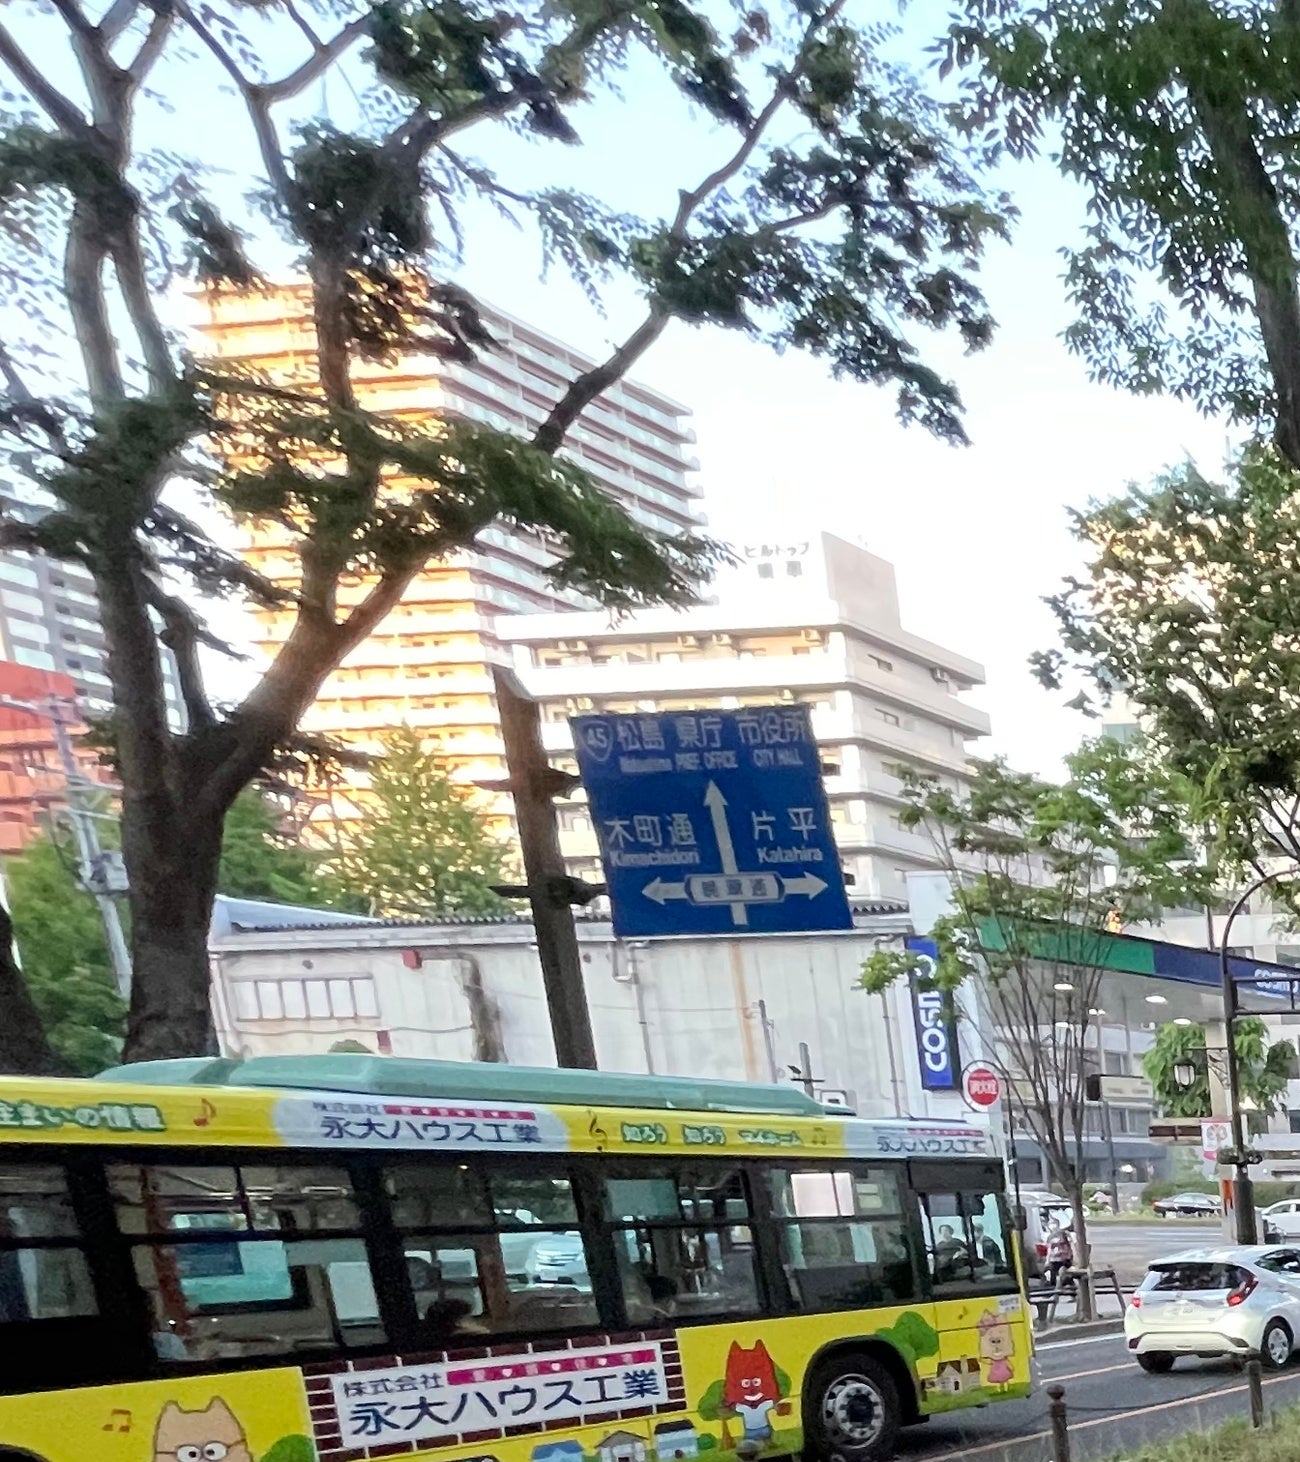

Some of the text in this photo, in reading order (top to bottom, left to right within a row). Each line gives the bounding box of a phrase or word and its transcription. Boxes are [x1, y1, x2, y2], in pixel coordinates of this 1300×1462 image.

[586, 728, 607, 745] 45
[616, 712, 806, 751] 松島 県庁 市役所
[604, 807, 817, 849] 木町通 片平
[757, 846, 823, 864] Katahira
[321, 1116, 541, 1143] 永大ハウス工業
[343, 1374, 445, 1399] 株式会社
[349, 1368, 661, 1437] 永大ハウス工業
